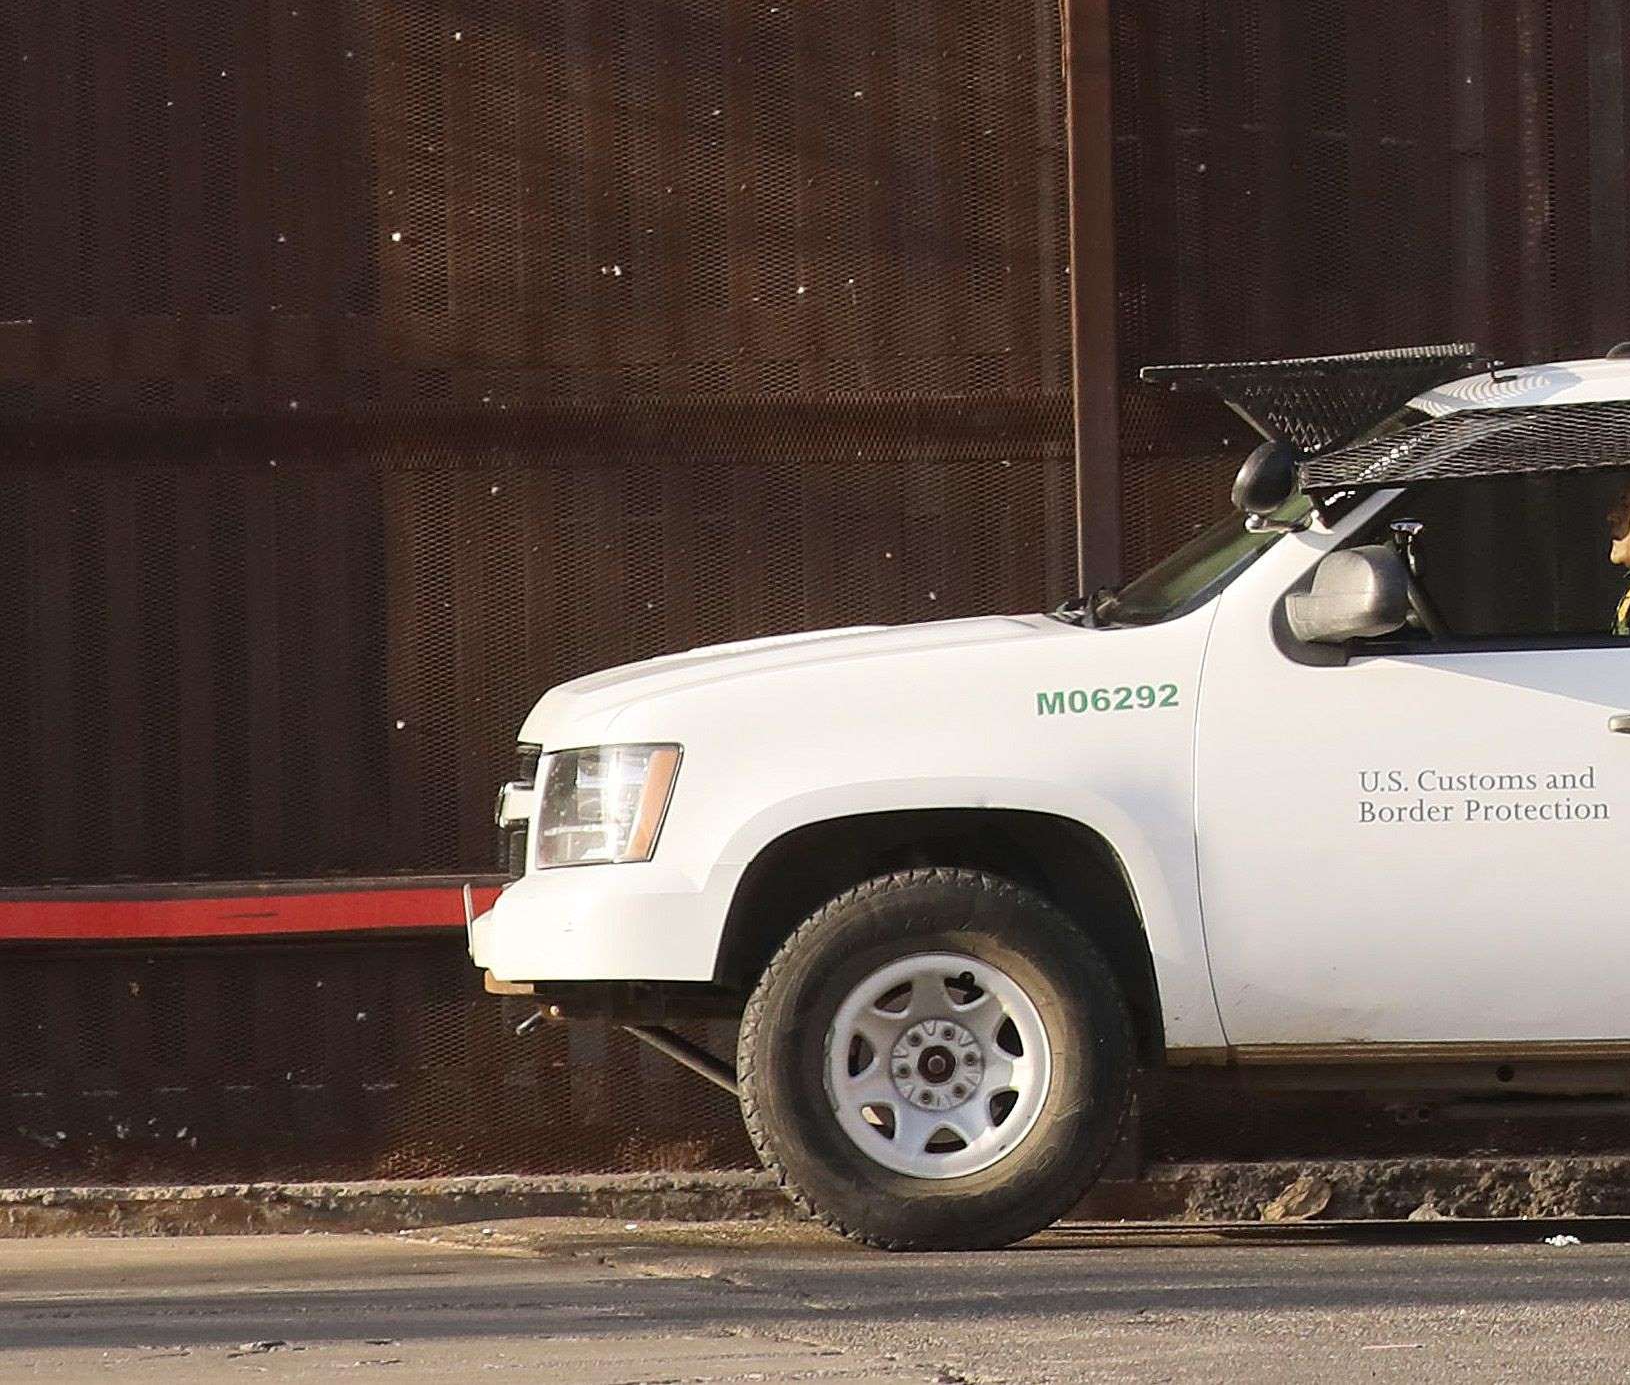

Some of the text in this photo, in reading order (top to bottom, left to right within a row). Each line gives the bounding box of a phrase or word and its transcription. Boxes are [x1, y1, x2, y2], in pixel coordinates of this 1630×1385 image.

[1036, 683, 1179, 716] M06292
[1358, 766, 1597, 793] U.S. Customs and
[1359, 797, 1610, 823] Border Protection
